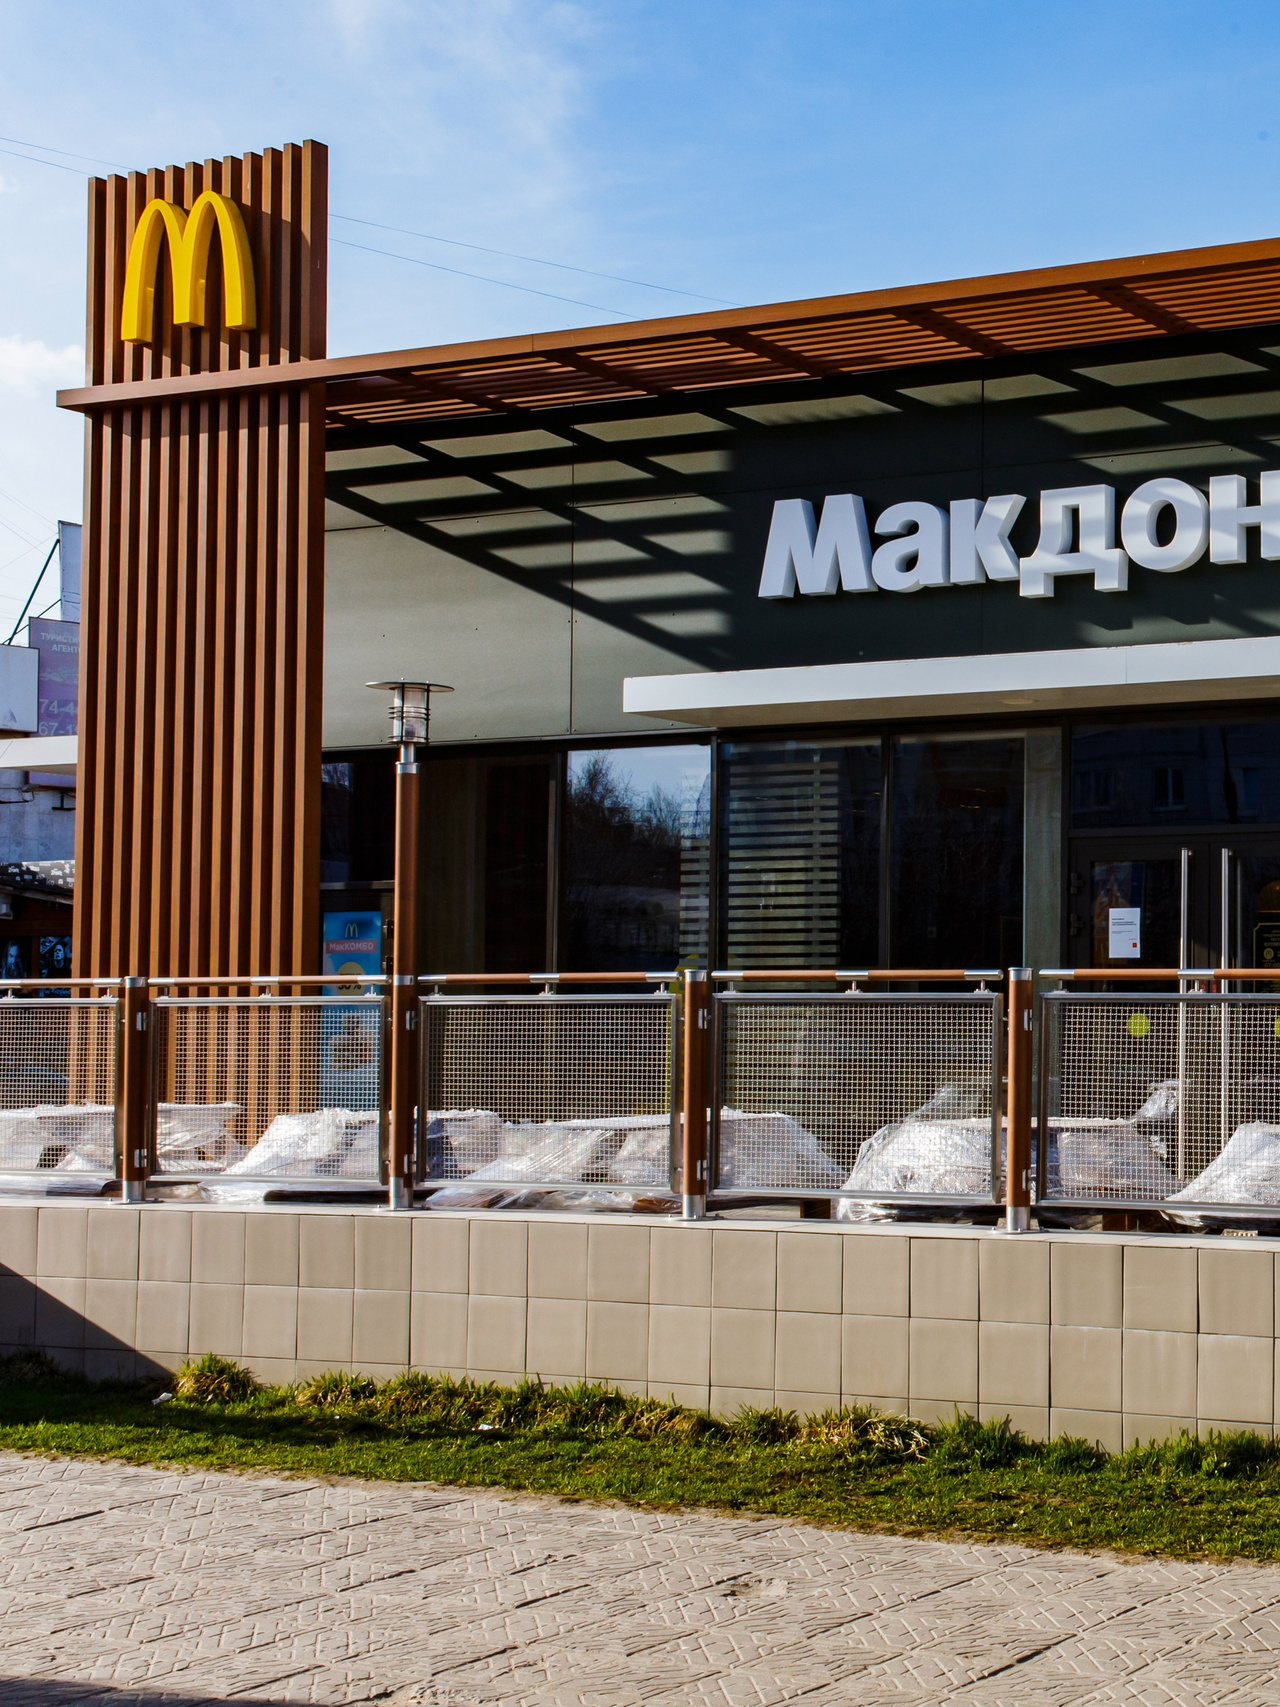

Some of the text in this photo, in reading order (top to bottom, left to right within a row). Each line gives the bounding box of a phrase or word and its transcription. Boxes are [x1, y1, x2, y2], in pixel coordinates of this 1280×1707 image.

[40, 632, 79, 643] ТУРИСТИ
[52, 644, 79, 653] АГЕНТ
[39, 698, 77, 715] 74-4
[38, 721, 77, 736] 67-1
[329, 942, 374, 951] МакКОМБО
